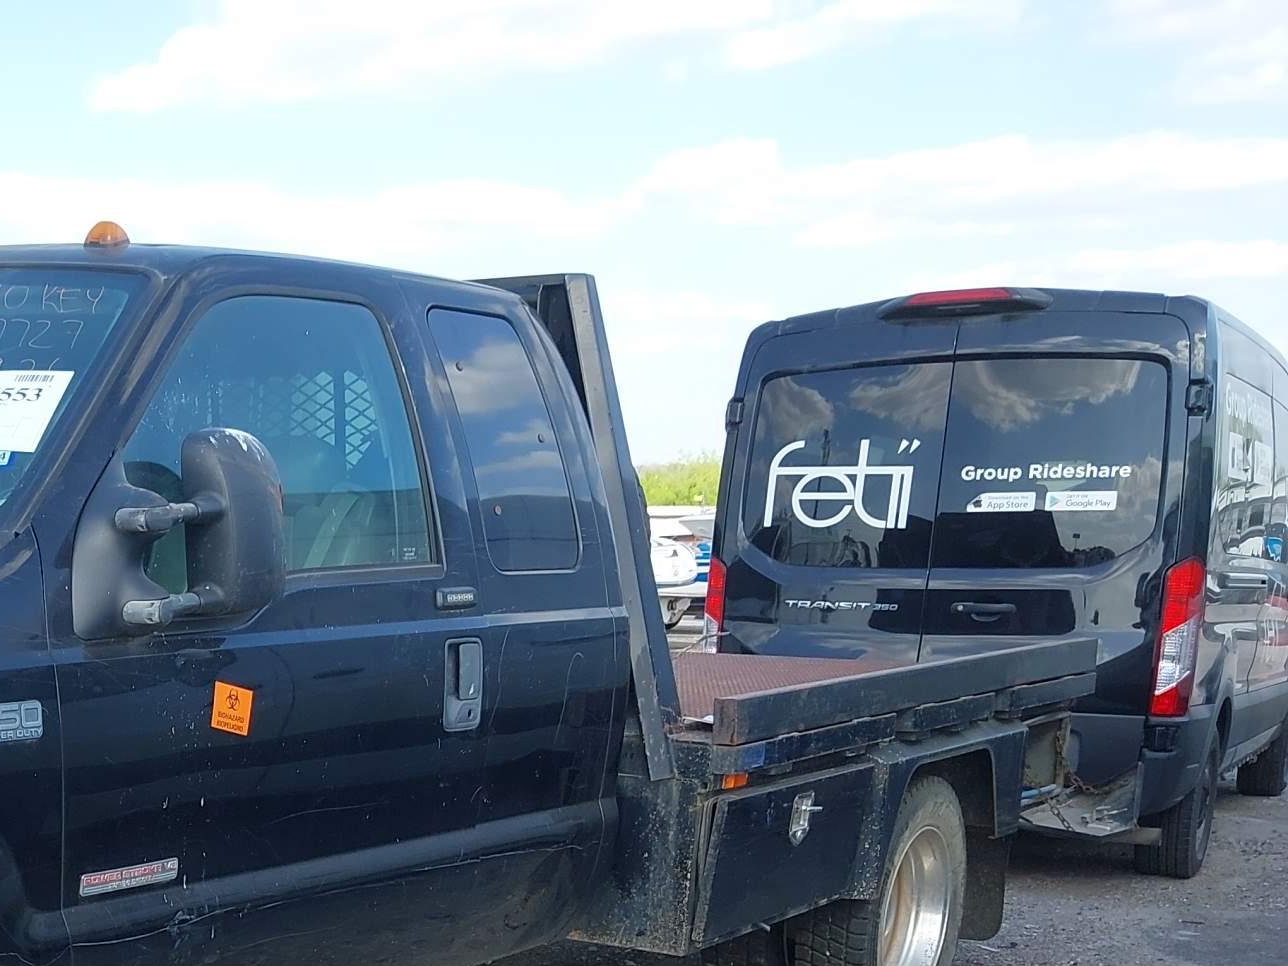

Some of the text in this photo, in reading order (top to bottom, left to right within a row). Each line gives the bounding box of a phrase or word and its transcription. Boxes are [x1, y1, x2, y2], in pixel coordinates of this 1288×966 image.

[42, 284, 104, 313] KEY
[961, 463, 1131, 482] Group Rideshare
[986, 501, 1029, 511] App Store
[1065, 499, 1112, 508] Google Play
[785, 600, 898, 611] TRANSIT 350
[16, 728, 43, 737] DUTY
